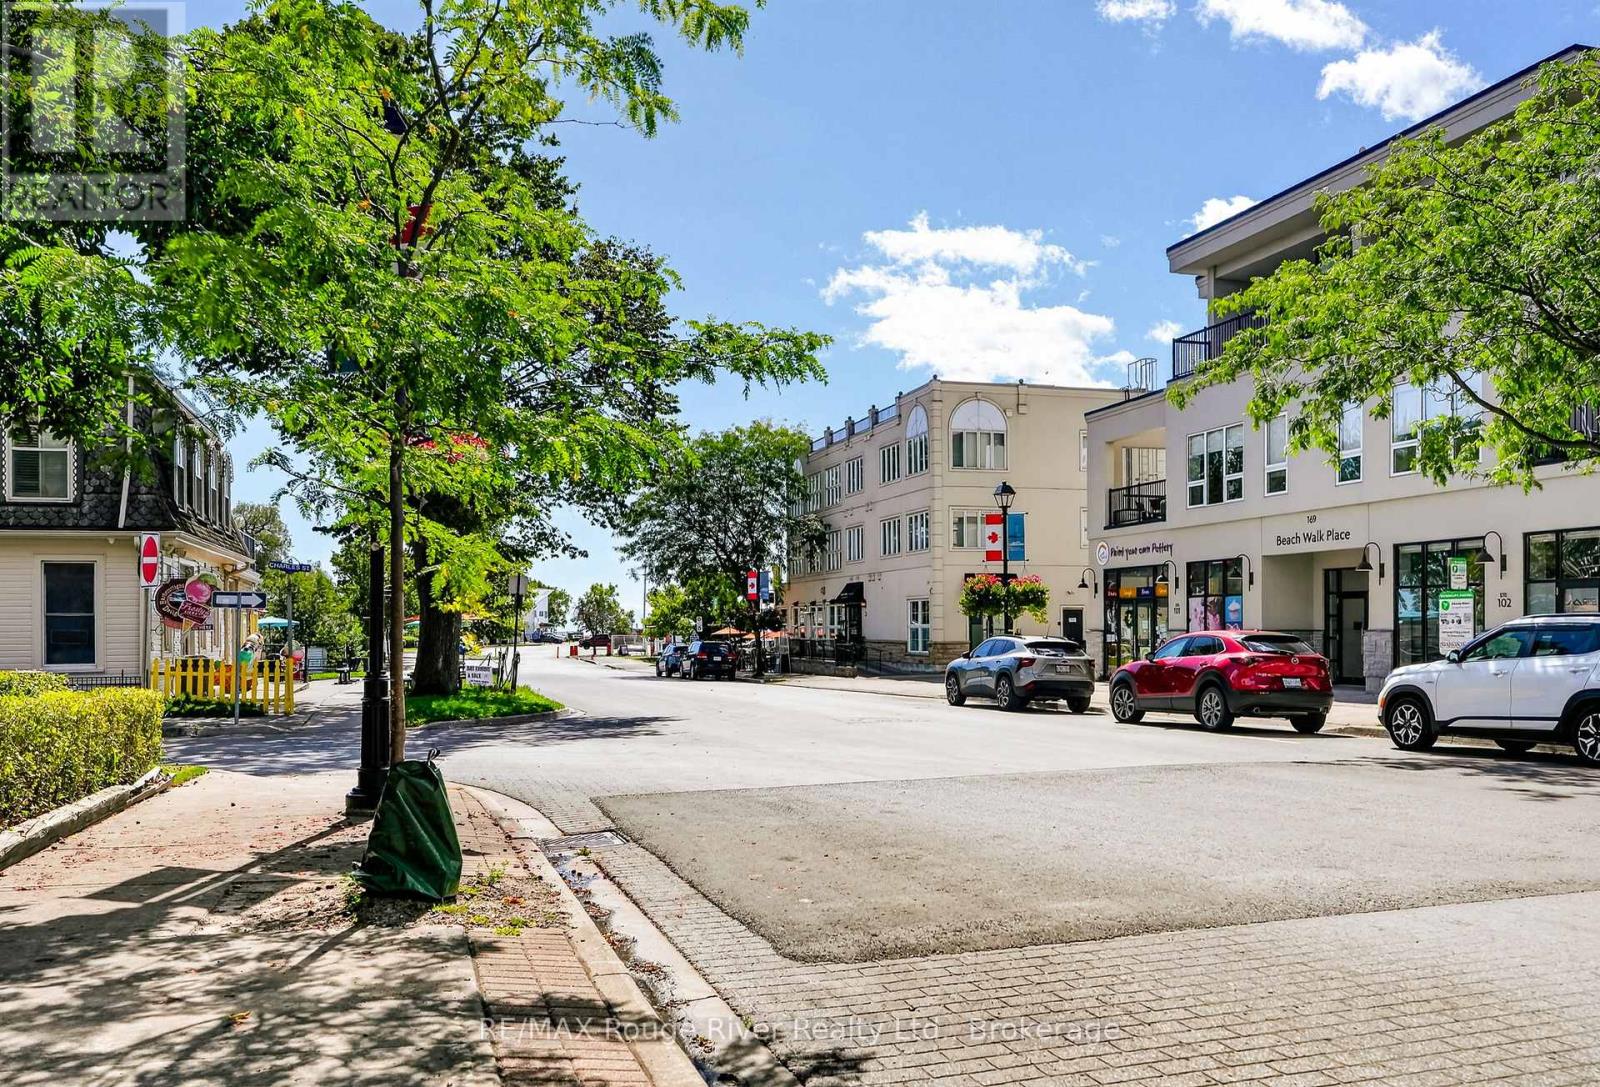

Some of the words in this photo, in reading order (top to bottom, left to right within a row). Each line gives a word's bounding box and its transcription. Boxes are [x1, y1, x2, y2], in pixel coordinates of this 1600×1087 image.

[1306, 514, 1317, 524] 169
[1276, 532, 1301, 546] Beach
[1302, 529, 1325, 543] Walk
[1326, 528, 1351, 541] Place
[269, 562, 300, 571] CHARLES
[1497, 598, 1512, 608] 102
